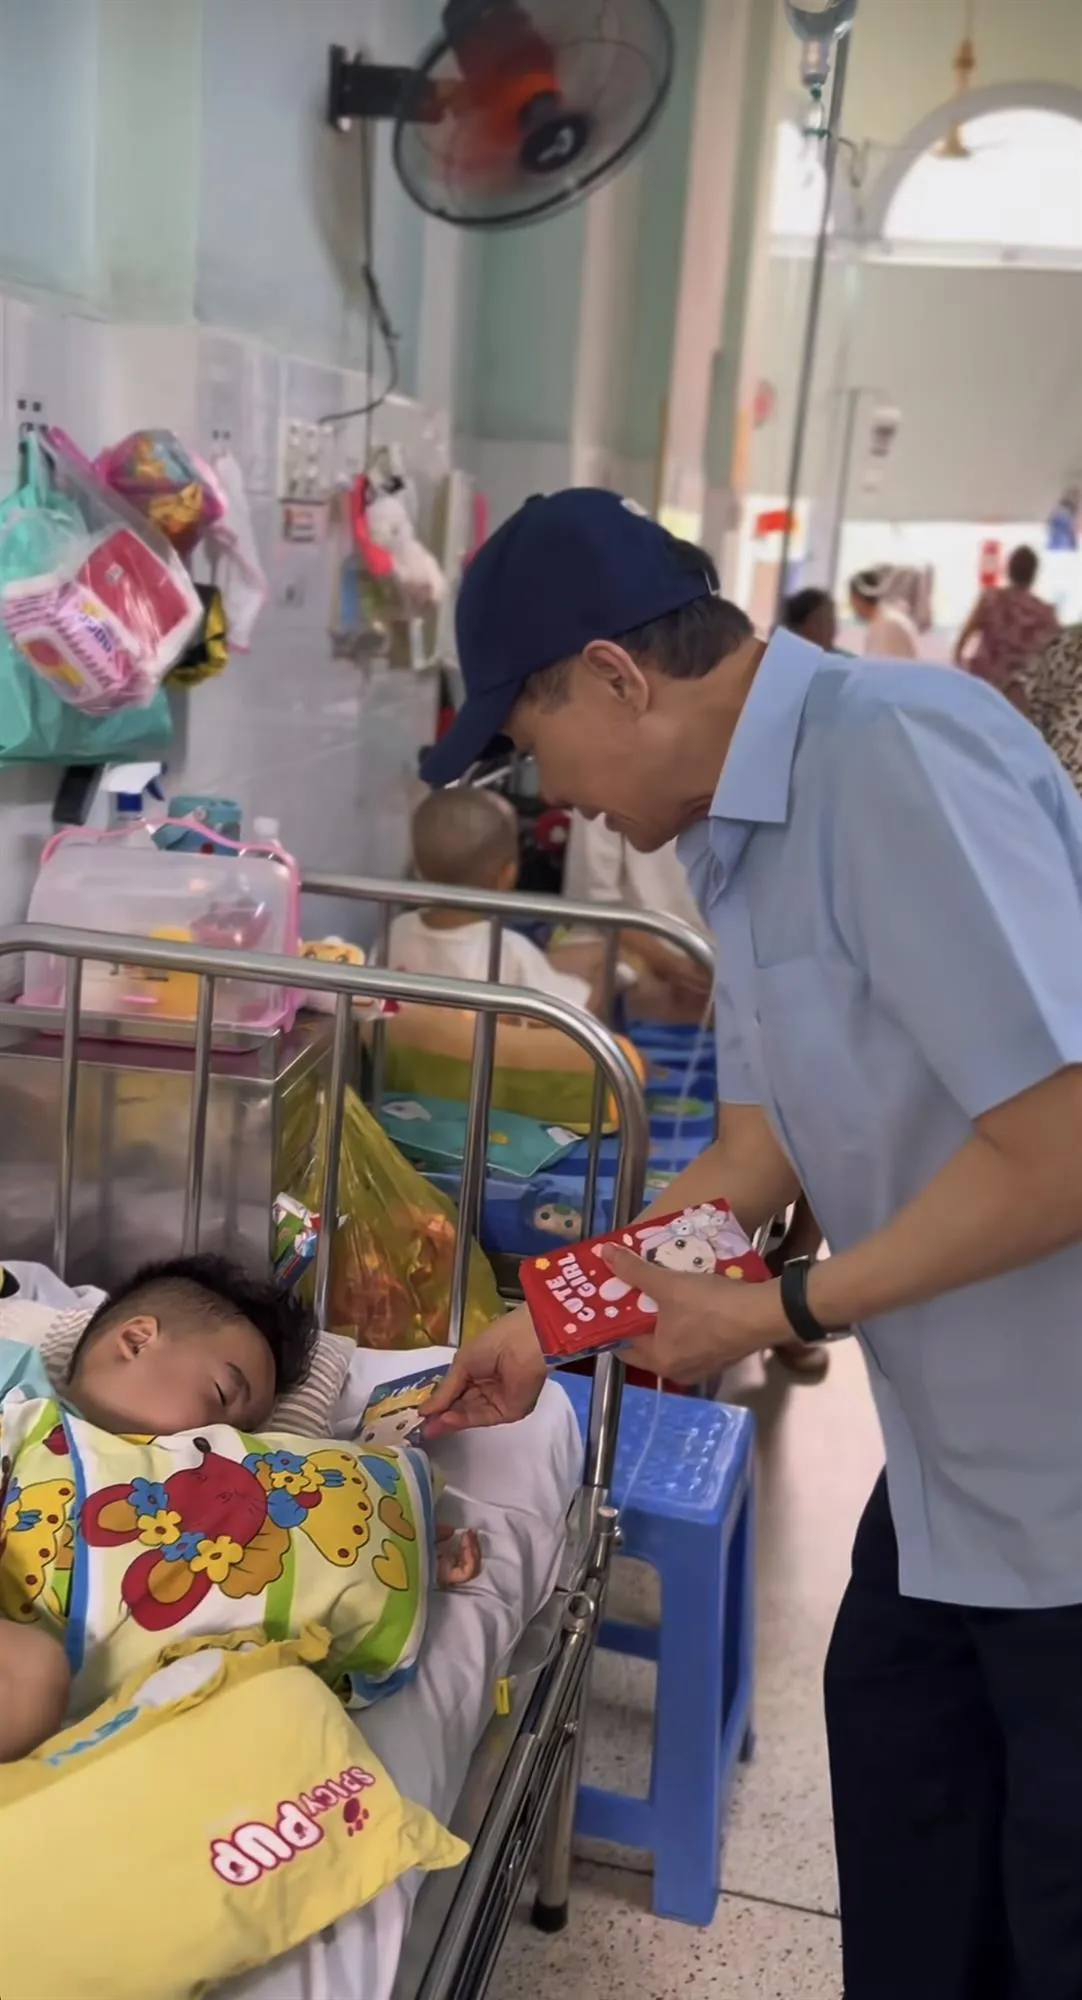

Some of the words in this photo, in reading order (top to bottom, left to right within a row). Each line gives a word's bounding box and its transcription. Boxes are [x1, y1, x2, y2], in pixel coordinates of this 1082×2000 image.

[545, 1275, 596, 1322] CUTE
[557, 1252, 597, 1298] GIRL
[299, 1766, 376, 1817] SPICY
[210, 1800, 325, 1886] PUP
